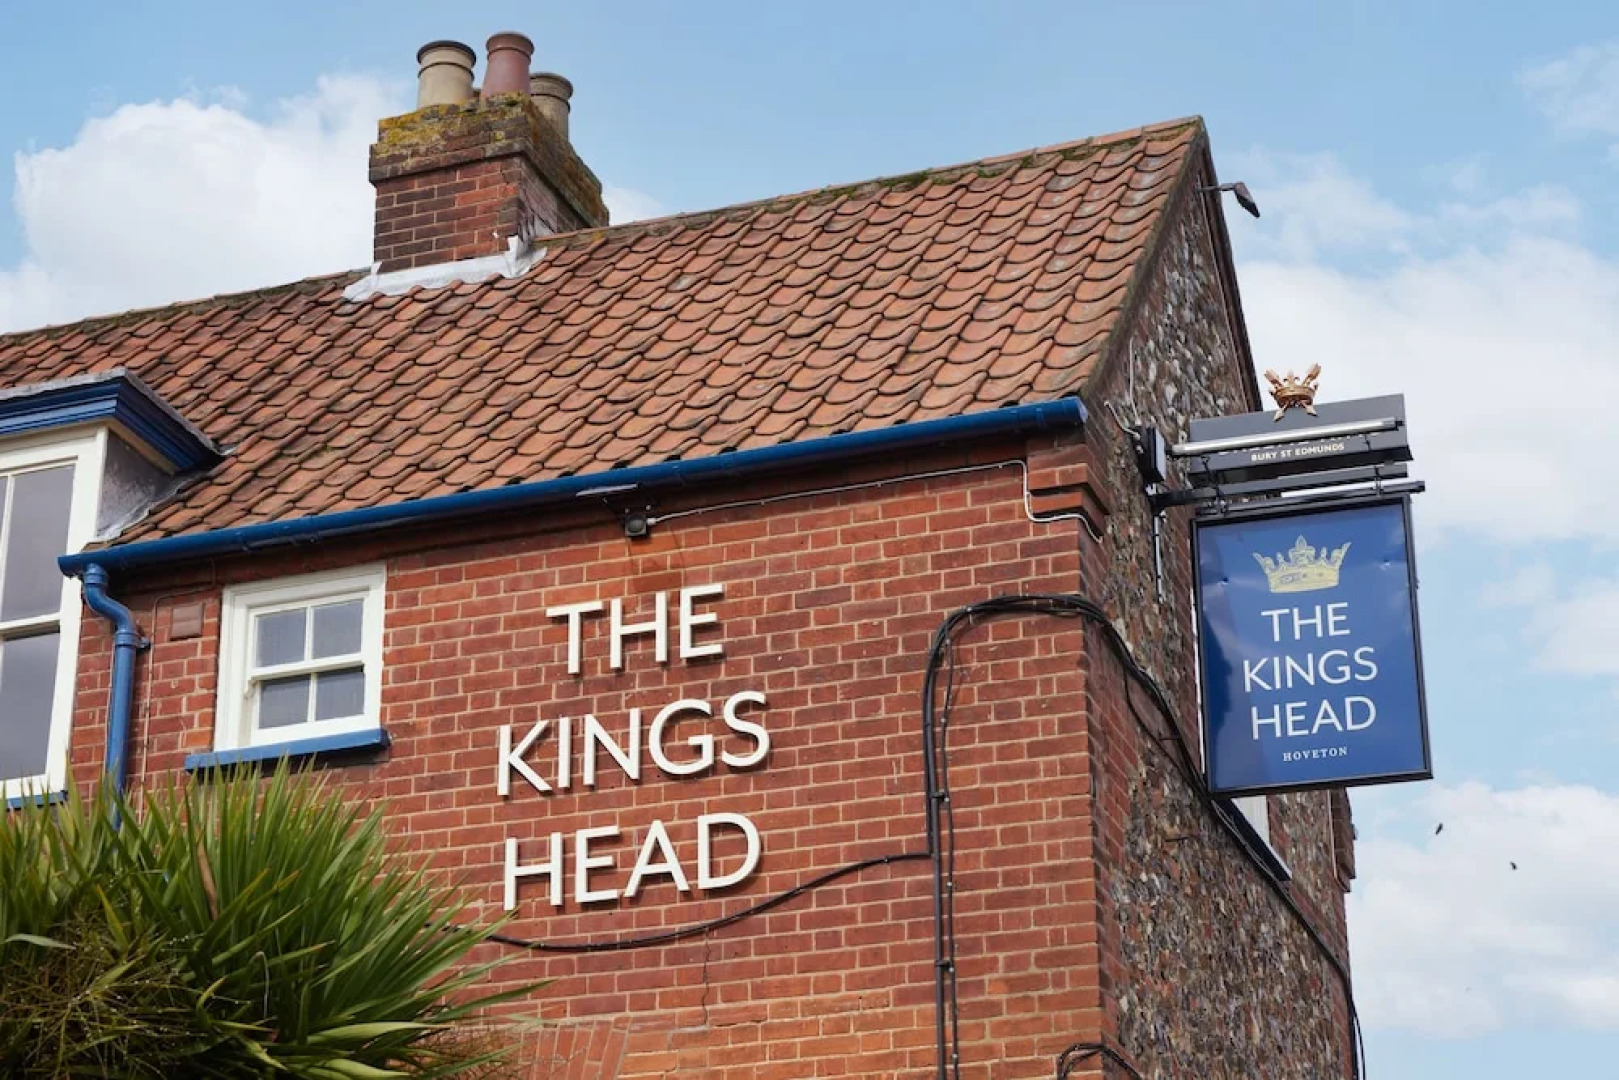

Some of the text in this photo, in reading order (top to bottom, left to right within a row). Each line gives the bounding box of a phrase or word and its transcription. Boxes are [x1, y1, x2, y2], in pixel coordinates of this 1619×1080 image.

[1251, 451, 1277, 461] BURY
[1280, 449, 1293, 458] ST
[1295, 442, 1345, 457] EDMUNDS
[546, 583, 724, 675] THE
[1261, 602, 1350, 642] THE
[1243, 646, 1378, 692] KINGS
[1252, 696, 1377, 740] HEAD
[497, 691, 771, 796] KINGS
[1283, 746, 1348, 762] HOVETON
[504, 812, 761, 911] HEAD
